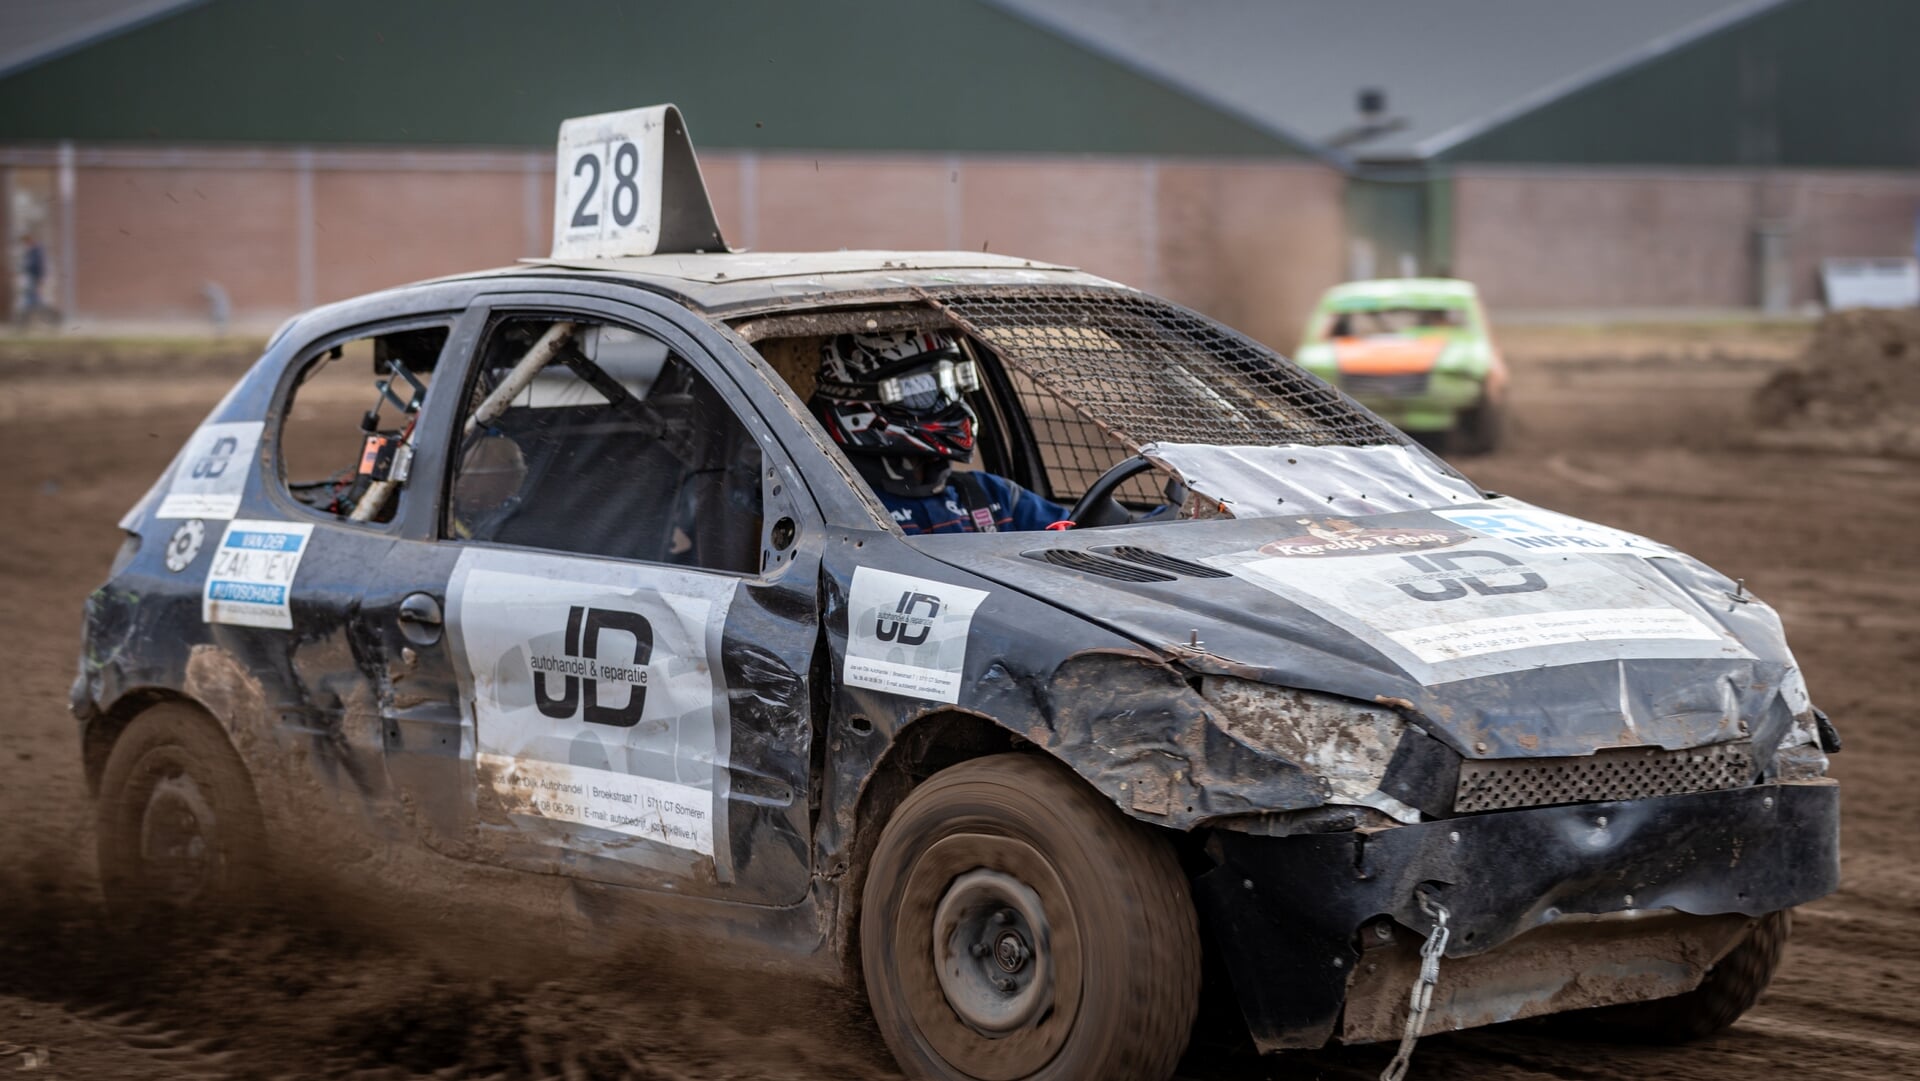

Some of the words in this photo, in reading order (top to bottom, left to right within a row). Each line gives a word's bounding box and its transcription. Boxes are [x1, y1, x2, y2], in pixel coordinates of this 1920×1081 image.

[570, 142, 639, 228] 28
[242, 534, 264, 548] VAN
[263, 535, 287, 550] DER
[1372, 532, 1450, 547] Kebap
[212, 583, 283, 604] AUTOSCHADE
[1394, 550, 1549, 602] JD
[875, 591, 941, 646] JD
[530, 655, 588, 677] autohandel
[590, 660, 598, 677] &
[600, 664, 648, 684] reparatie
[533, 605, 654, 728] JD
[540, 779, 583, 795] Autohandel
[593, 786, 632, 804] Broekstraat
[633, 793, 638, 805] 7
[664, 800, 674, 813] CT
[675, 804, 705, 820] Someren
